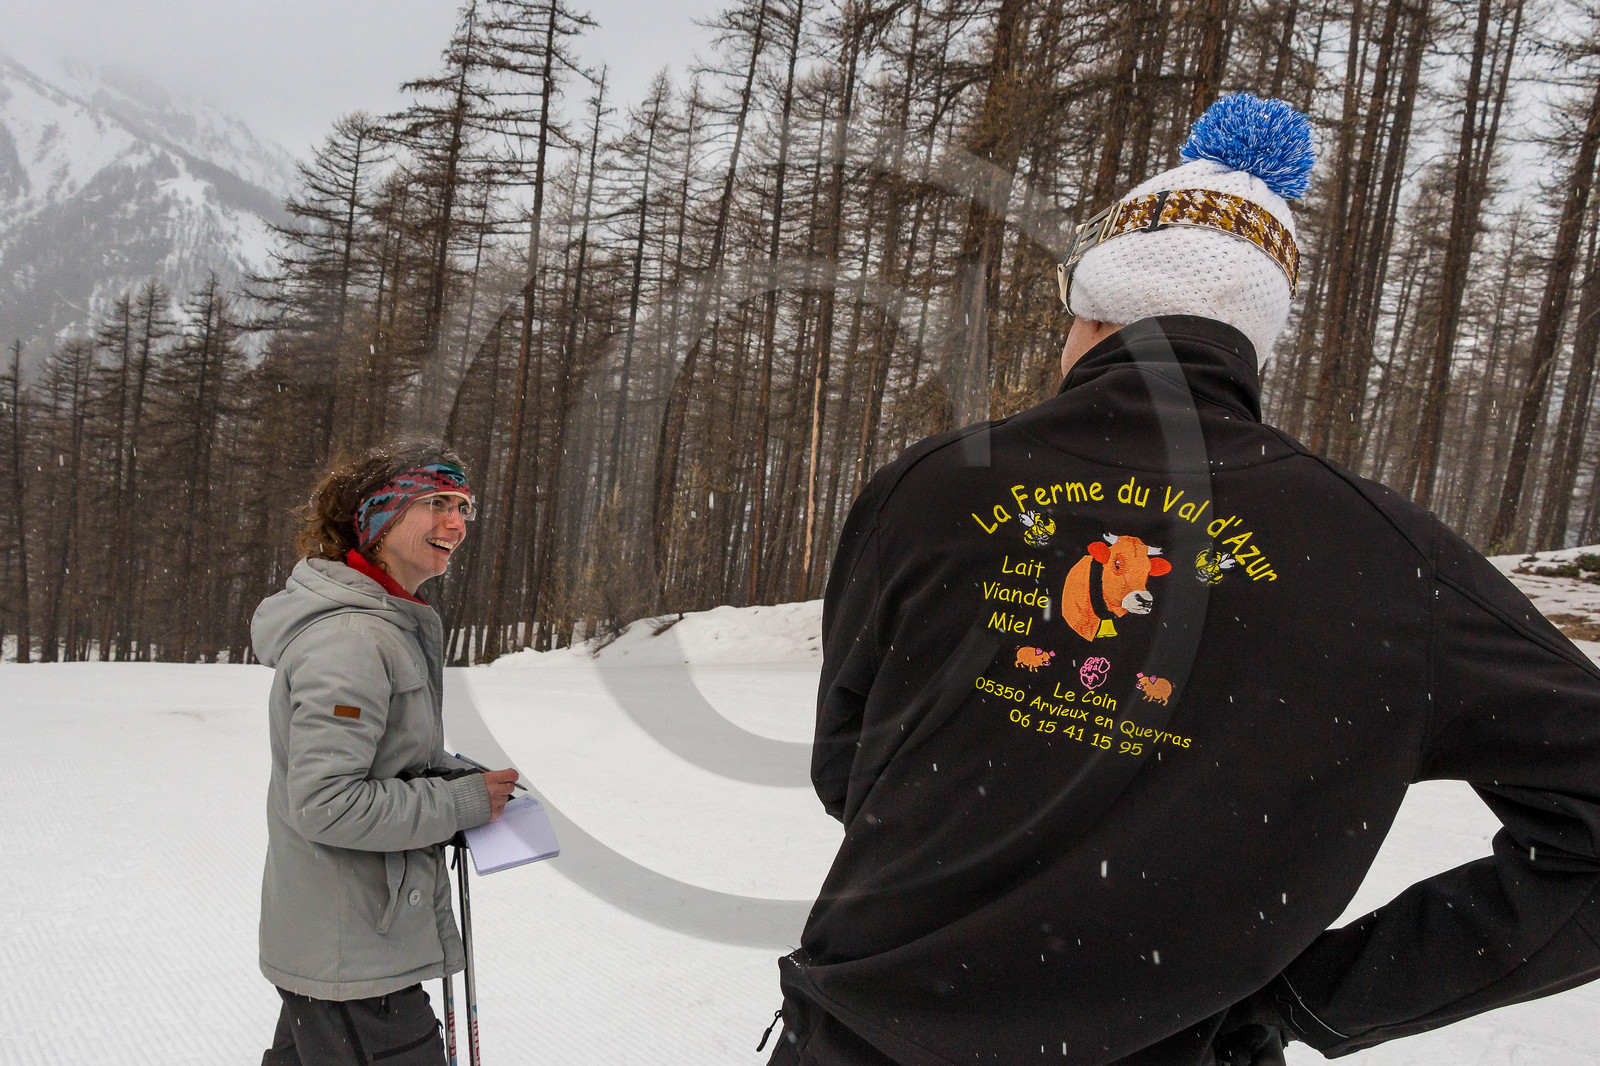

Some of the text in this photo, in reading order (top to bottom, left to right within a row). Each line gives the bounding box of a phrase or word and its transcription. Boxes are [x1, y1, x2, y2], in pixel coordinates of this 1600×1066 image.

[971, 476, 1278, 582] La Ferme du Val d'Azur
[1001, 555, 1046, 579] Lait
[983, 581, 1049, 609] Viande
[987, 611, 1033, 636] Miel
[1053, 681, 1117, 712] Le Coin
[975, 676, 1192, 749] 05350 Arvieux en Queyras
[1009, 708, 1143, 756] 06 15 41 15 95
